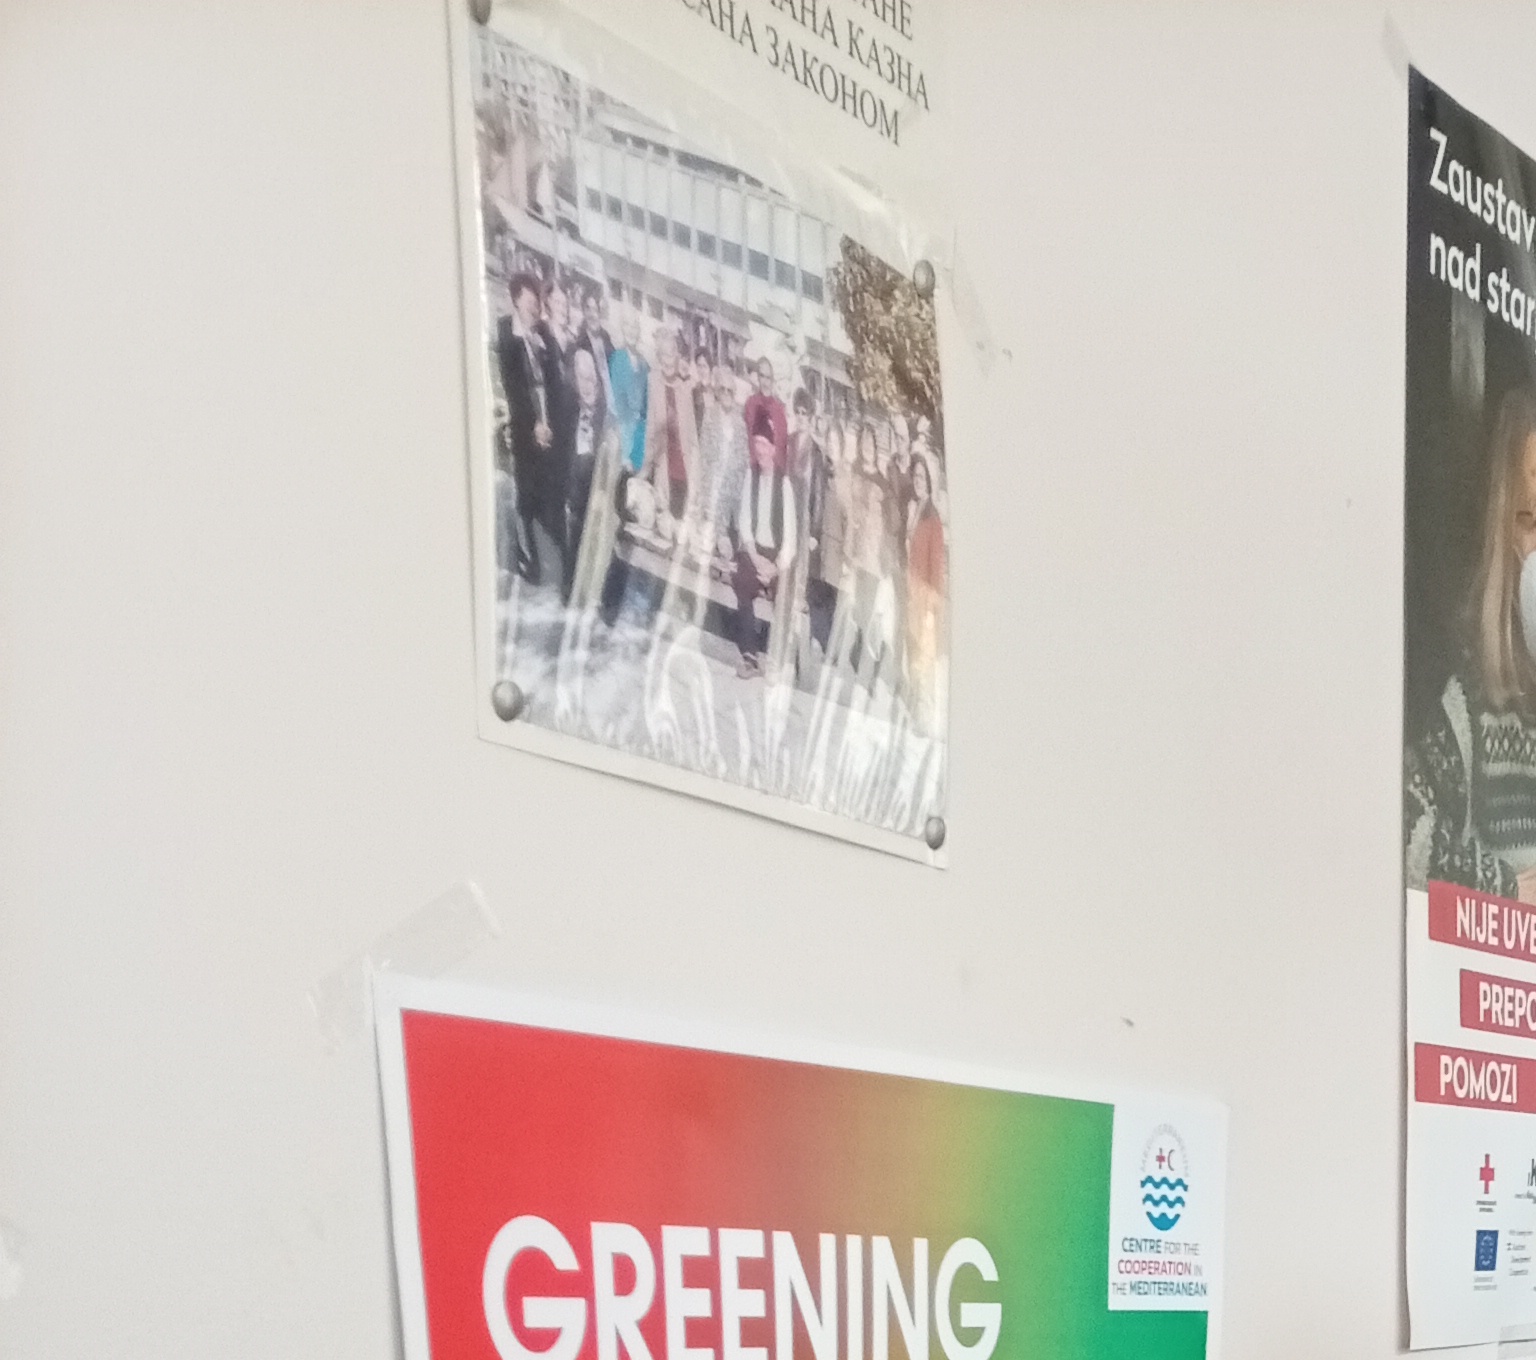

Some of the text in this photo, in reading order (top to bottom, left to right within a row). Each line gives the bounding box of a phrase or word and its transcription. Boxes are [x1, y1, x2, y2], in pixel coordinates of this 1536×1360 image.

[682, 0, 899, 146] АНА ЗАКОНОМ
[770, 0, 929, 111] АНА КАЗНА
[1430, 232, 1481, 302] nad
[1456, 896, 1499, 946] NIJE
[1439, 1055, 1517, 1104] POMOZI
[1117, 1259, 1192, 1276] COOPERATION
[1121, 1237, 1200, 1256] CENTRE FOR THE
[1111, 1280, 1208, 1297] THE MEDITERRANEAN
